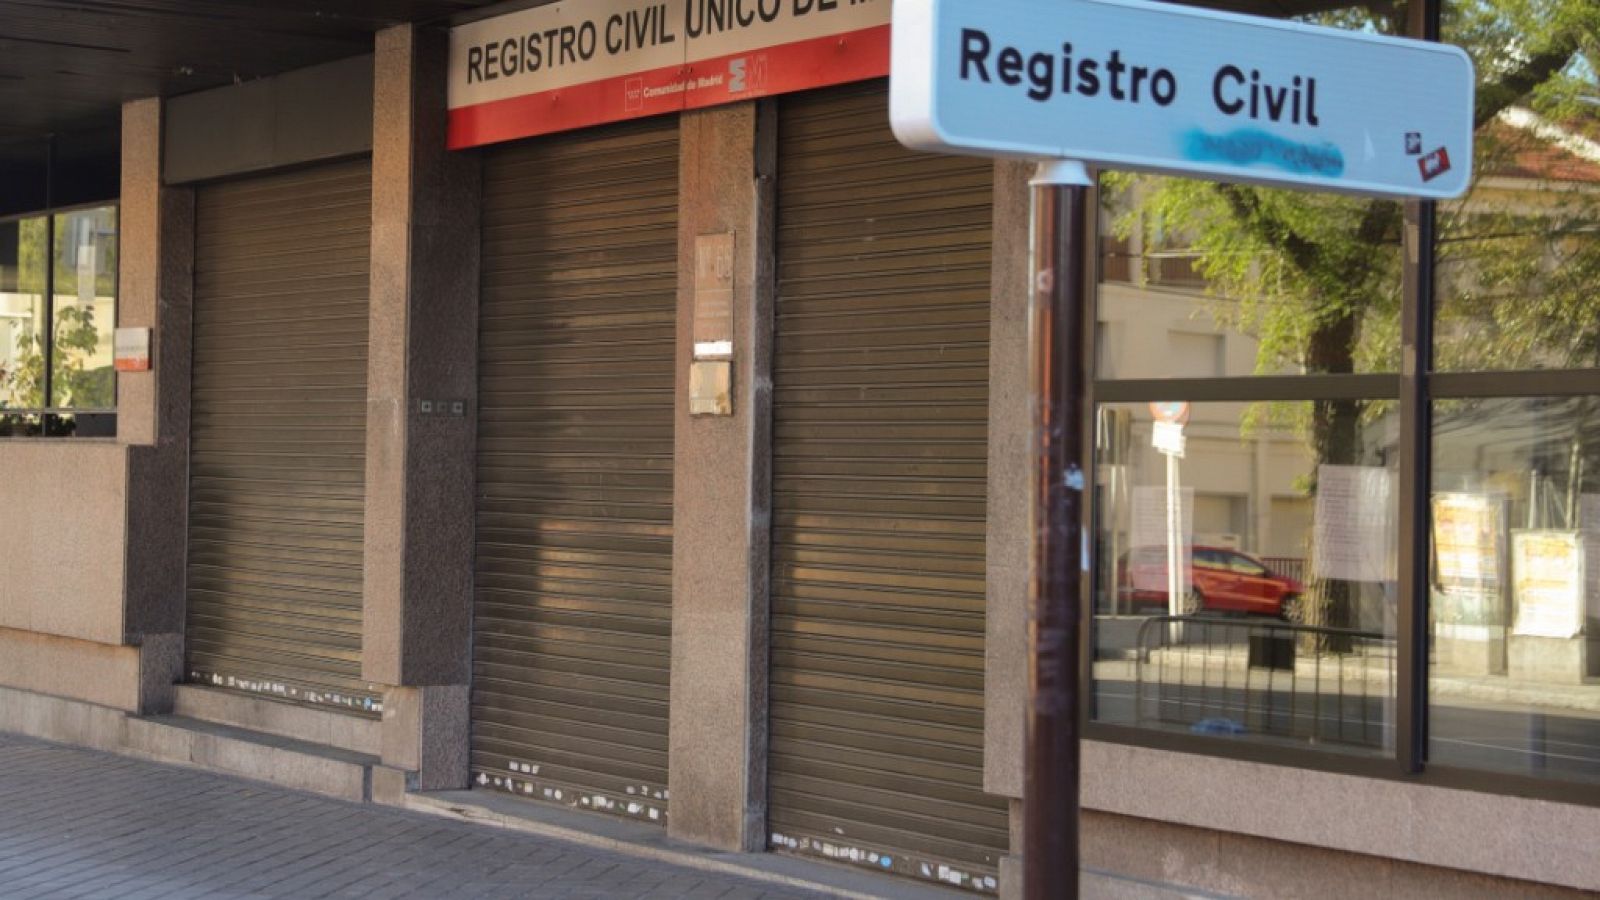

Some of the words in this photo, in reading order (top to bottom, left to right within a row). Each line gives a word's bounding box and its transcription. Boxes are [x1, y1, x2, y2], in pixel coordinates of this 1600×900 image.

[467, 20, 597, 84] REGISTRO
[605, 4, 675, 55] CIVIL
[960, 27, 1177, 106] Registro
[1212, 64, 1319, 126] Civil
[643, 80, 685, 98] Comunidad
[697, 74, 723, 88] Madrid
